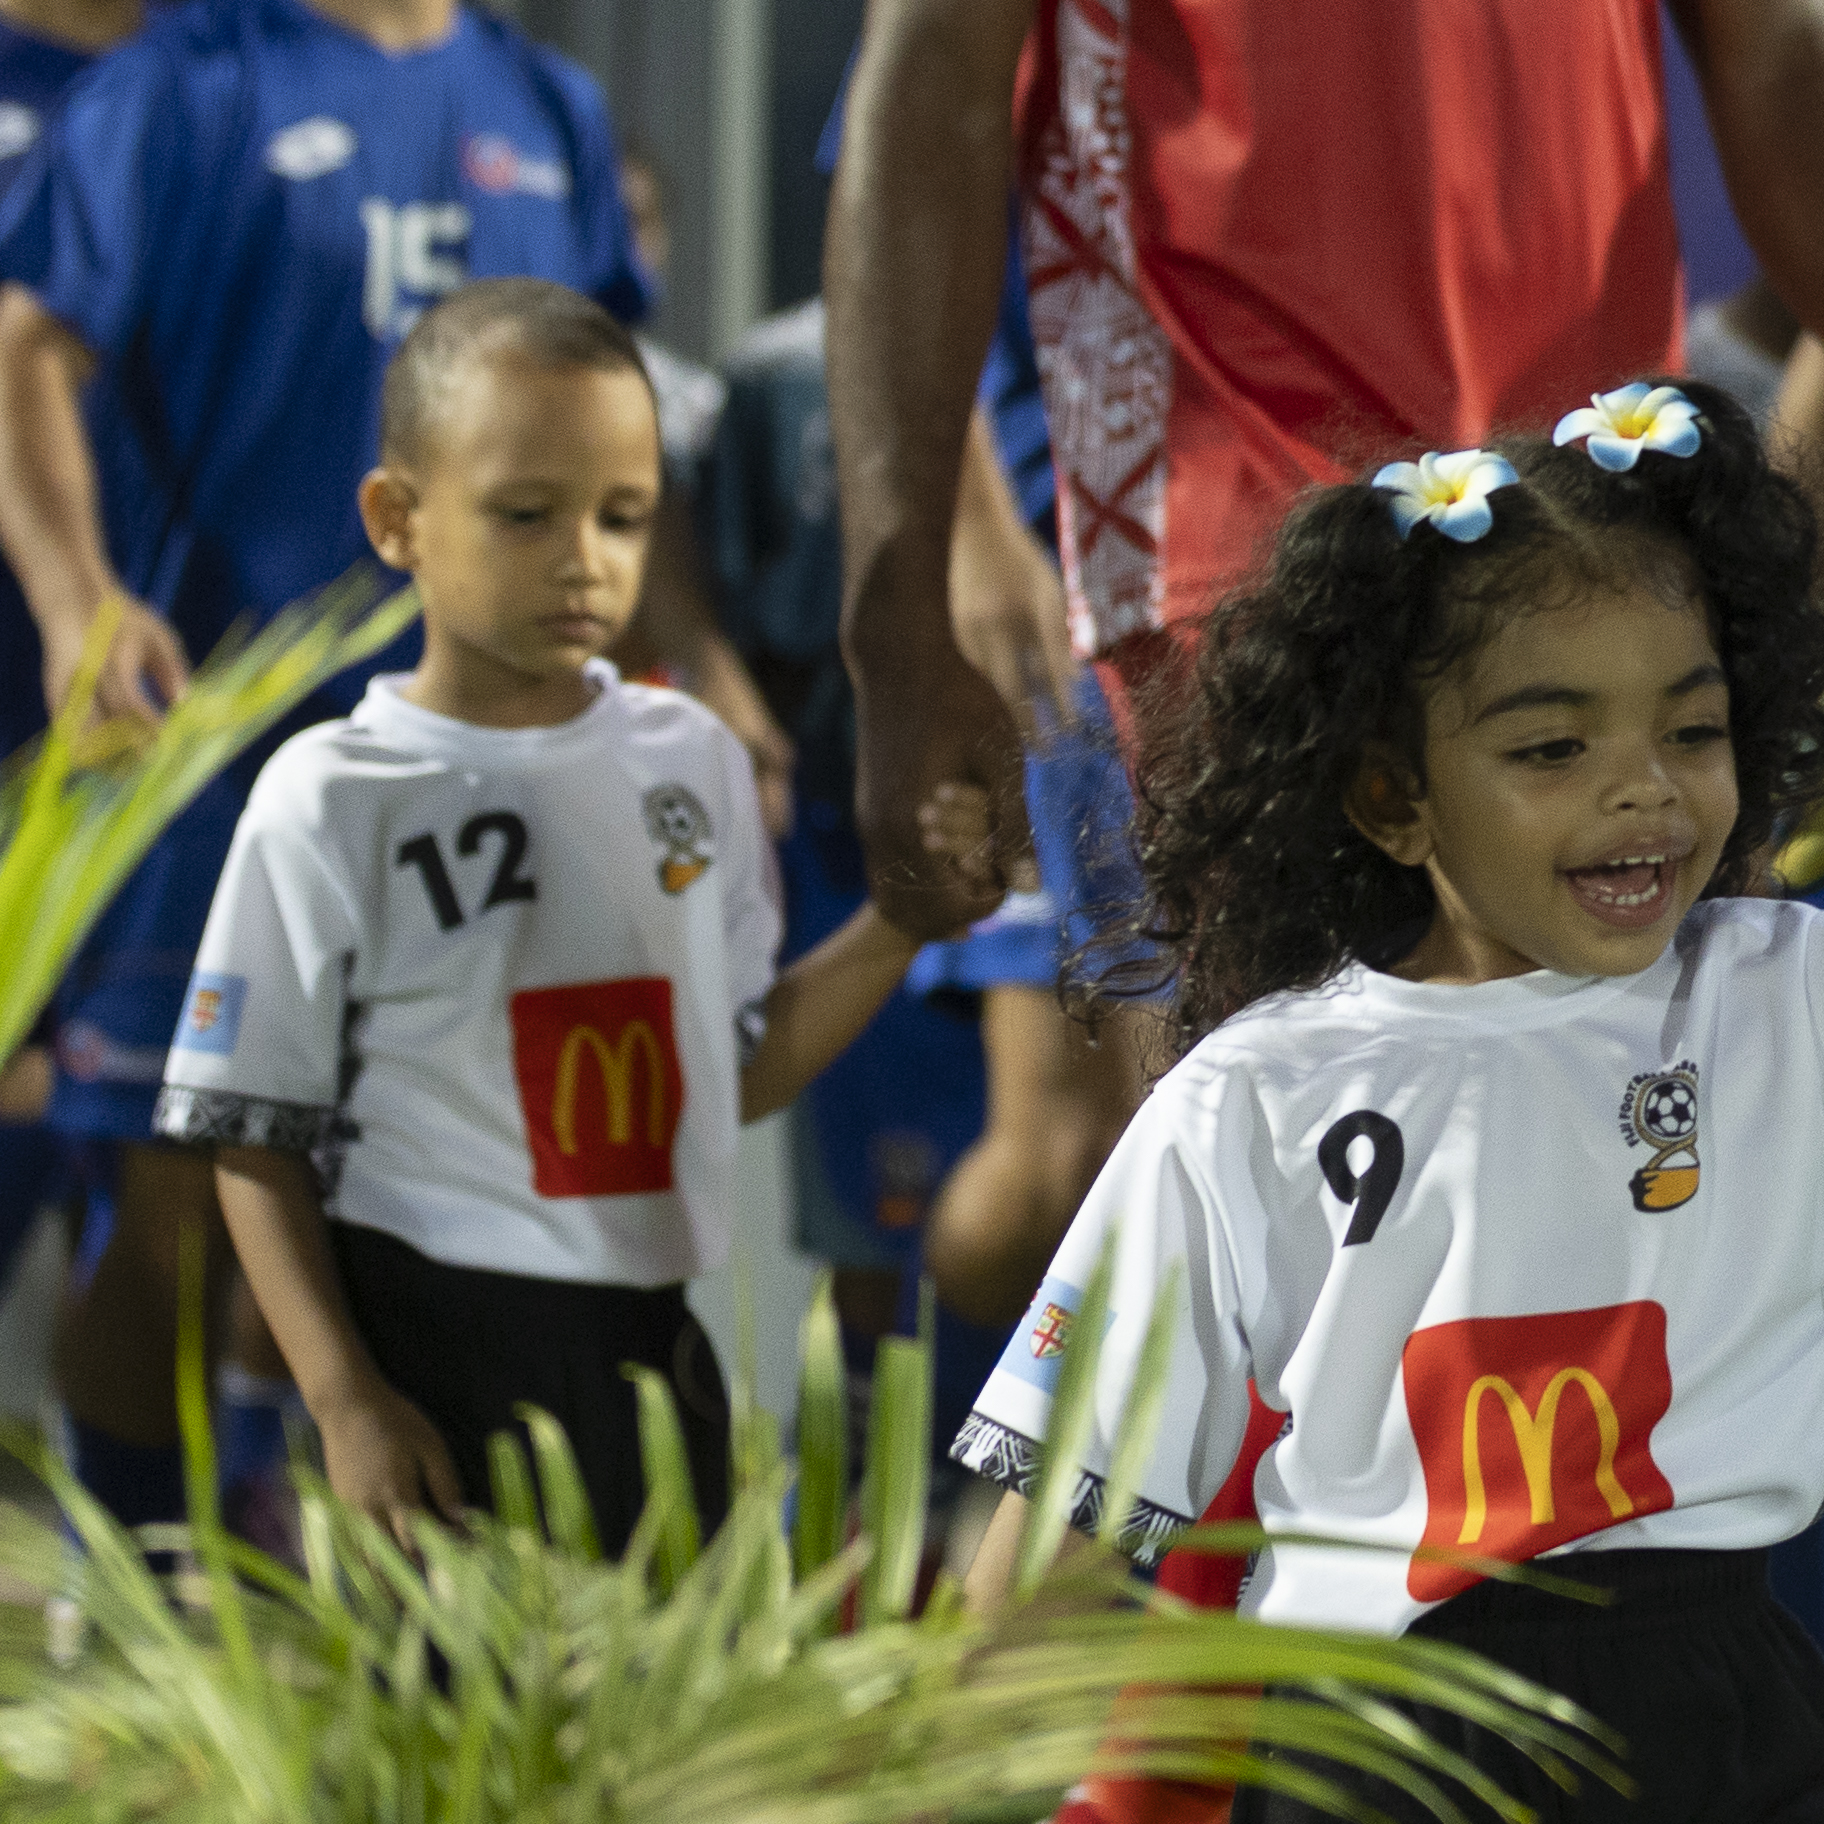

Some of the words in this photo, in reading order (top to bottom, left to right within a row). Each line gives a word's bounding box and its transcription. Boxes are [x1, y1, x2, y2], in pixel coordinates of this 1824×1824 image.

[359, 196, 473, 342] 15
[399, 810, 538, 932] 12
[1317, 1109, 1404, 1248] 9
